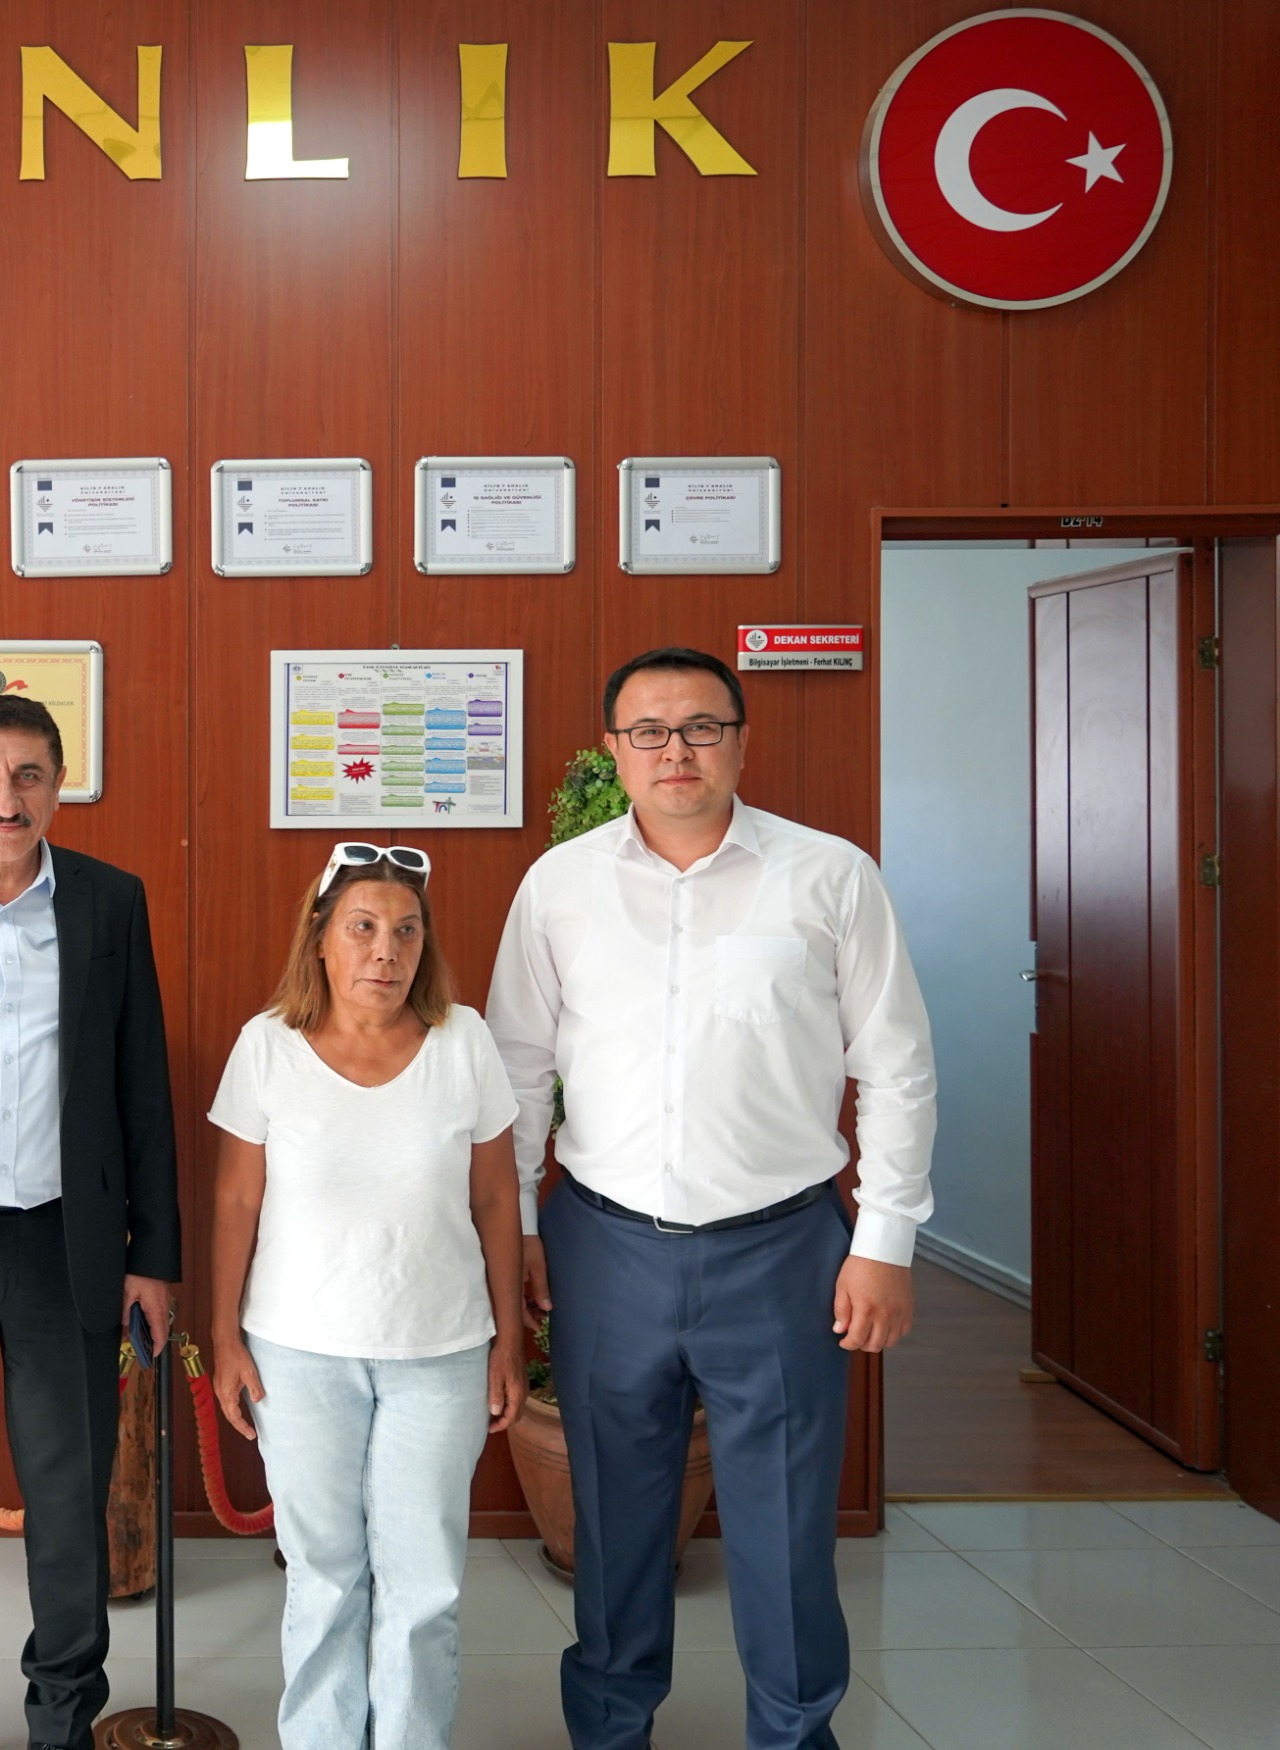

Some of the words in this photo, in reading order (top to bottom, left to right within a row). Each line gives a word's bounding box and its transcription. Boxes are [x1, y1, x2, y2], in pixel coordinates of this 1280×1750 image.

[774, 636, 807, 644] DEKAN
[810, 634, 859, 644] SEKRETERİ
[749, 658, 780, 668] Bilgisayar
[781, 656, 808, 667] İşletmeni
[833, 658, 853, 667] KILINÇ
